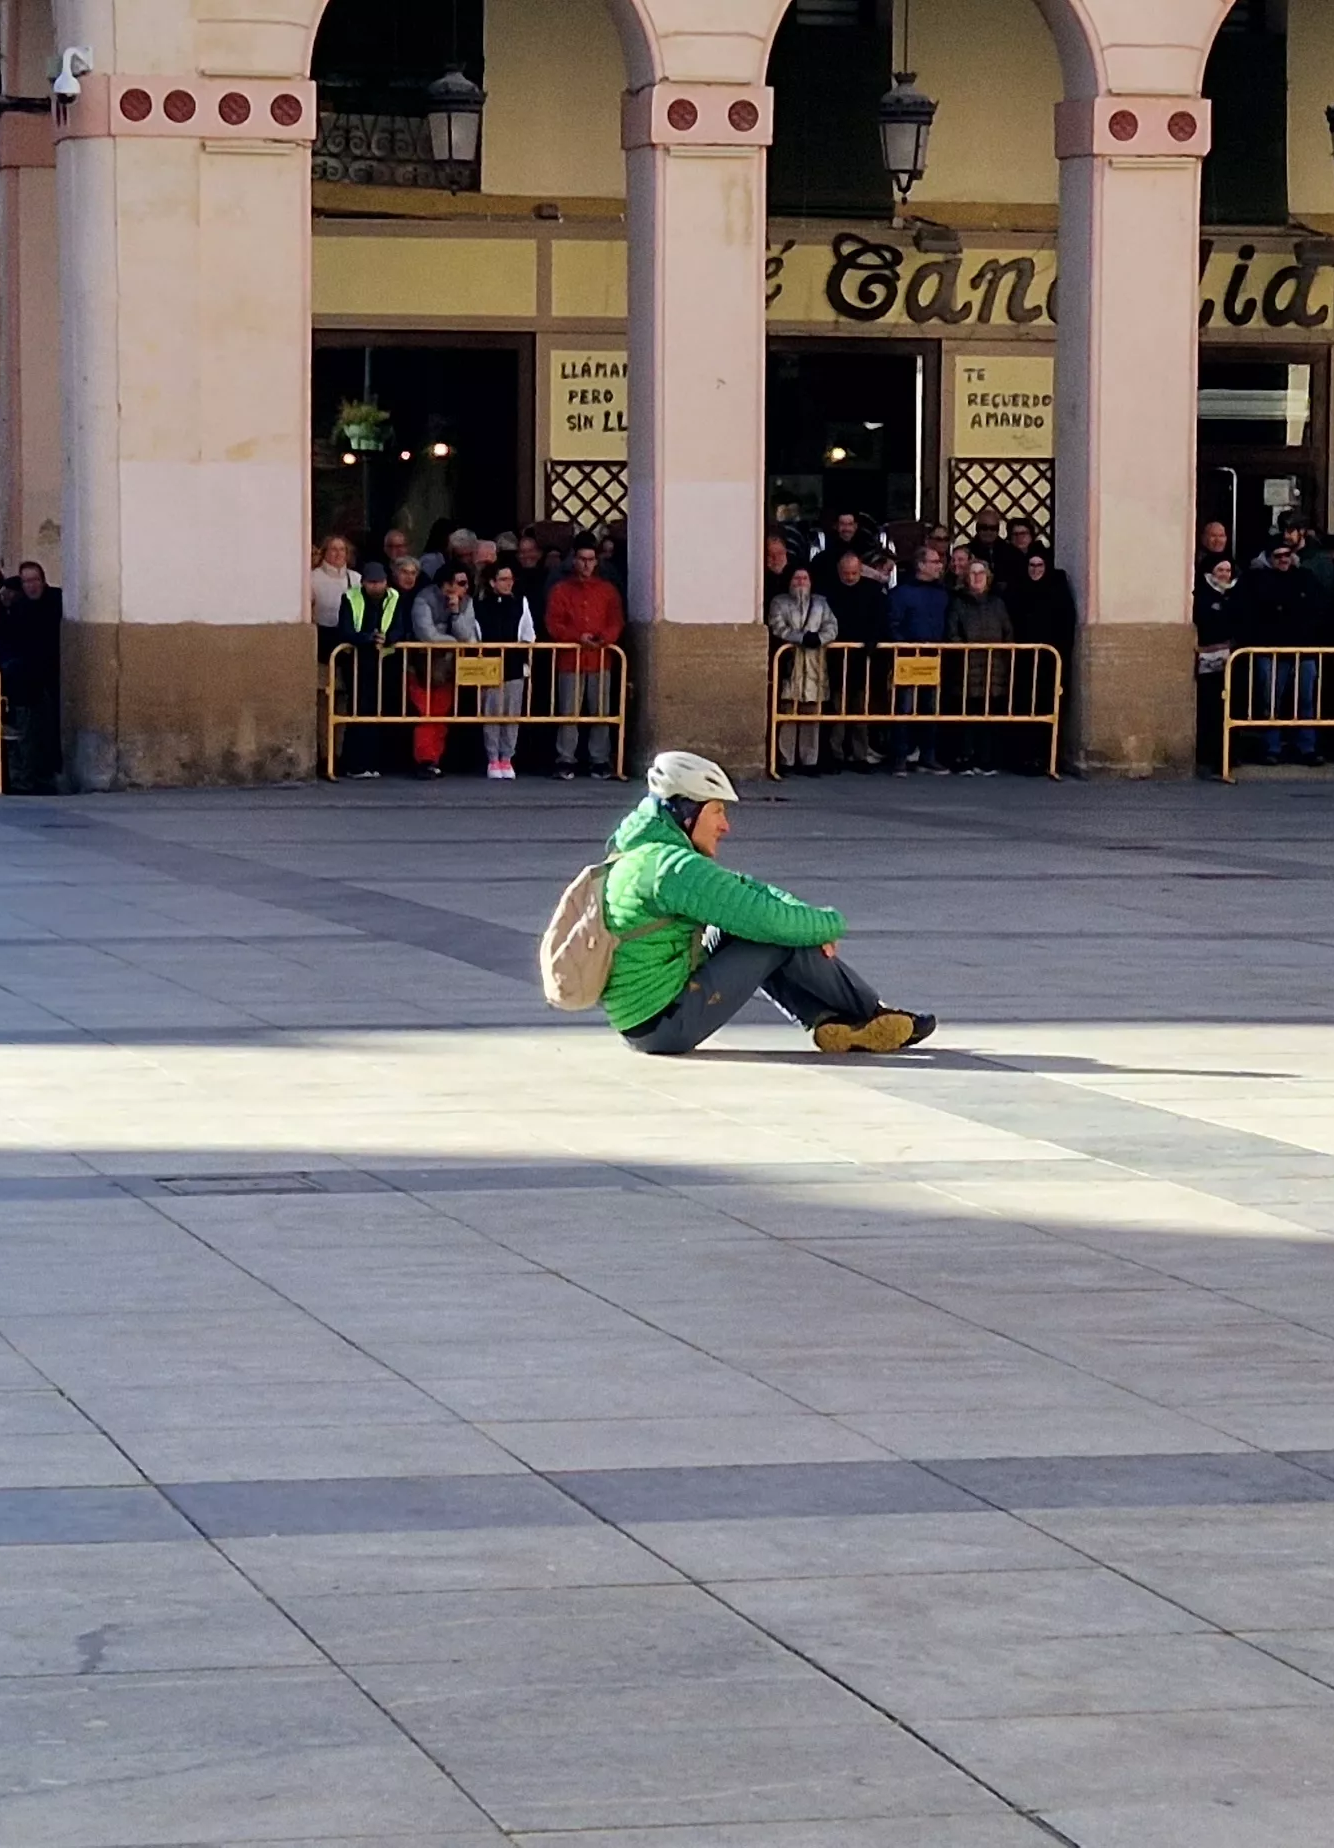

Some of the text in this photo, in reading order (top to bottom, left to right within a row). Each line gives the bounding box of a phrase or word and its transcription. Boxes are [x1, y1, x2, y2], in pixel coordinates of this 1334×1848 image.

[963, 367, 986, 383] TE
[568, 388, 613, 405] PERO
[967, 393, 1053, 409] RECUERDO
[566, 412, 594, 432] SIN
[970, 412, 1044, 429] AMANDO
